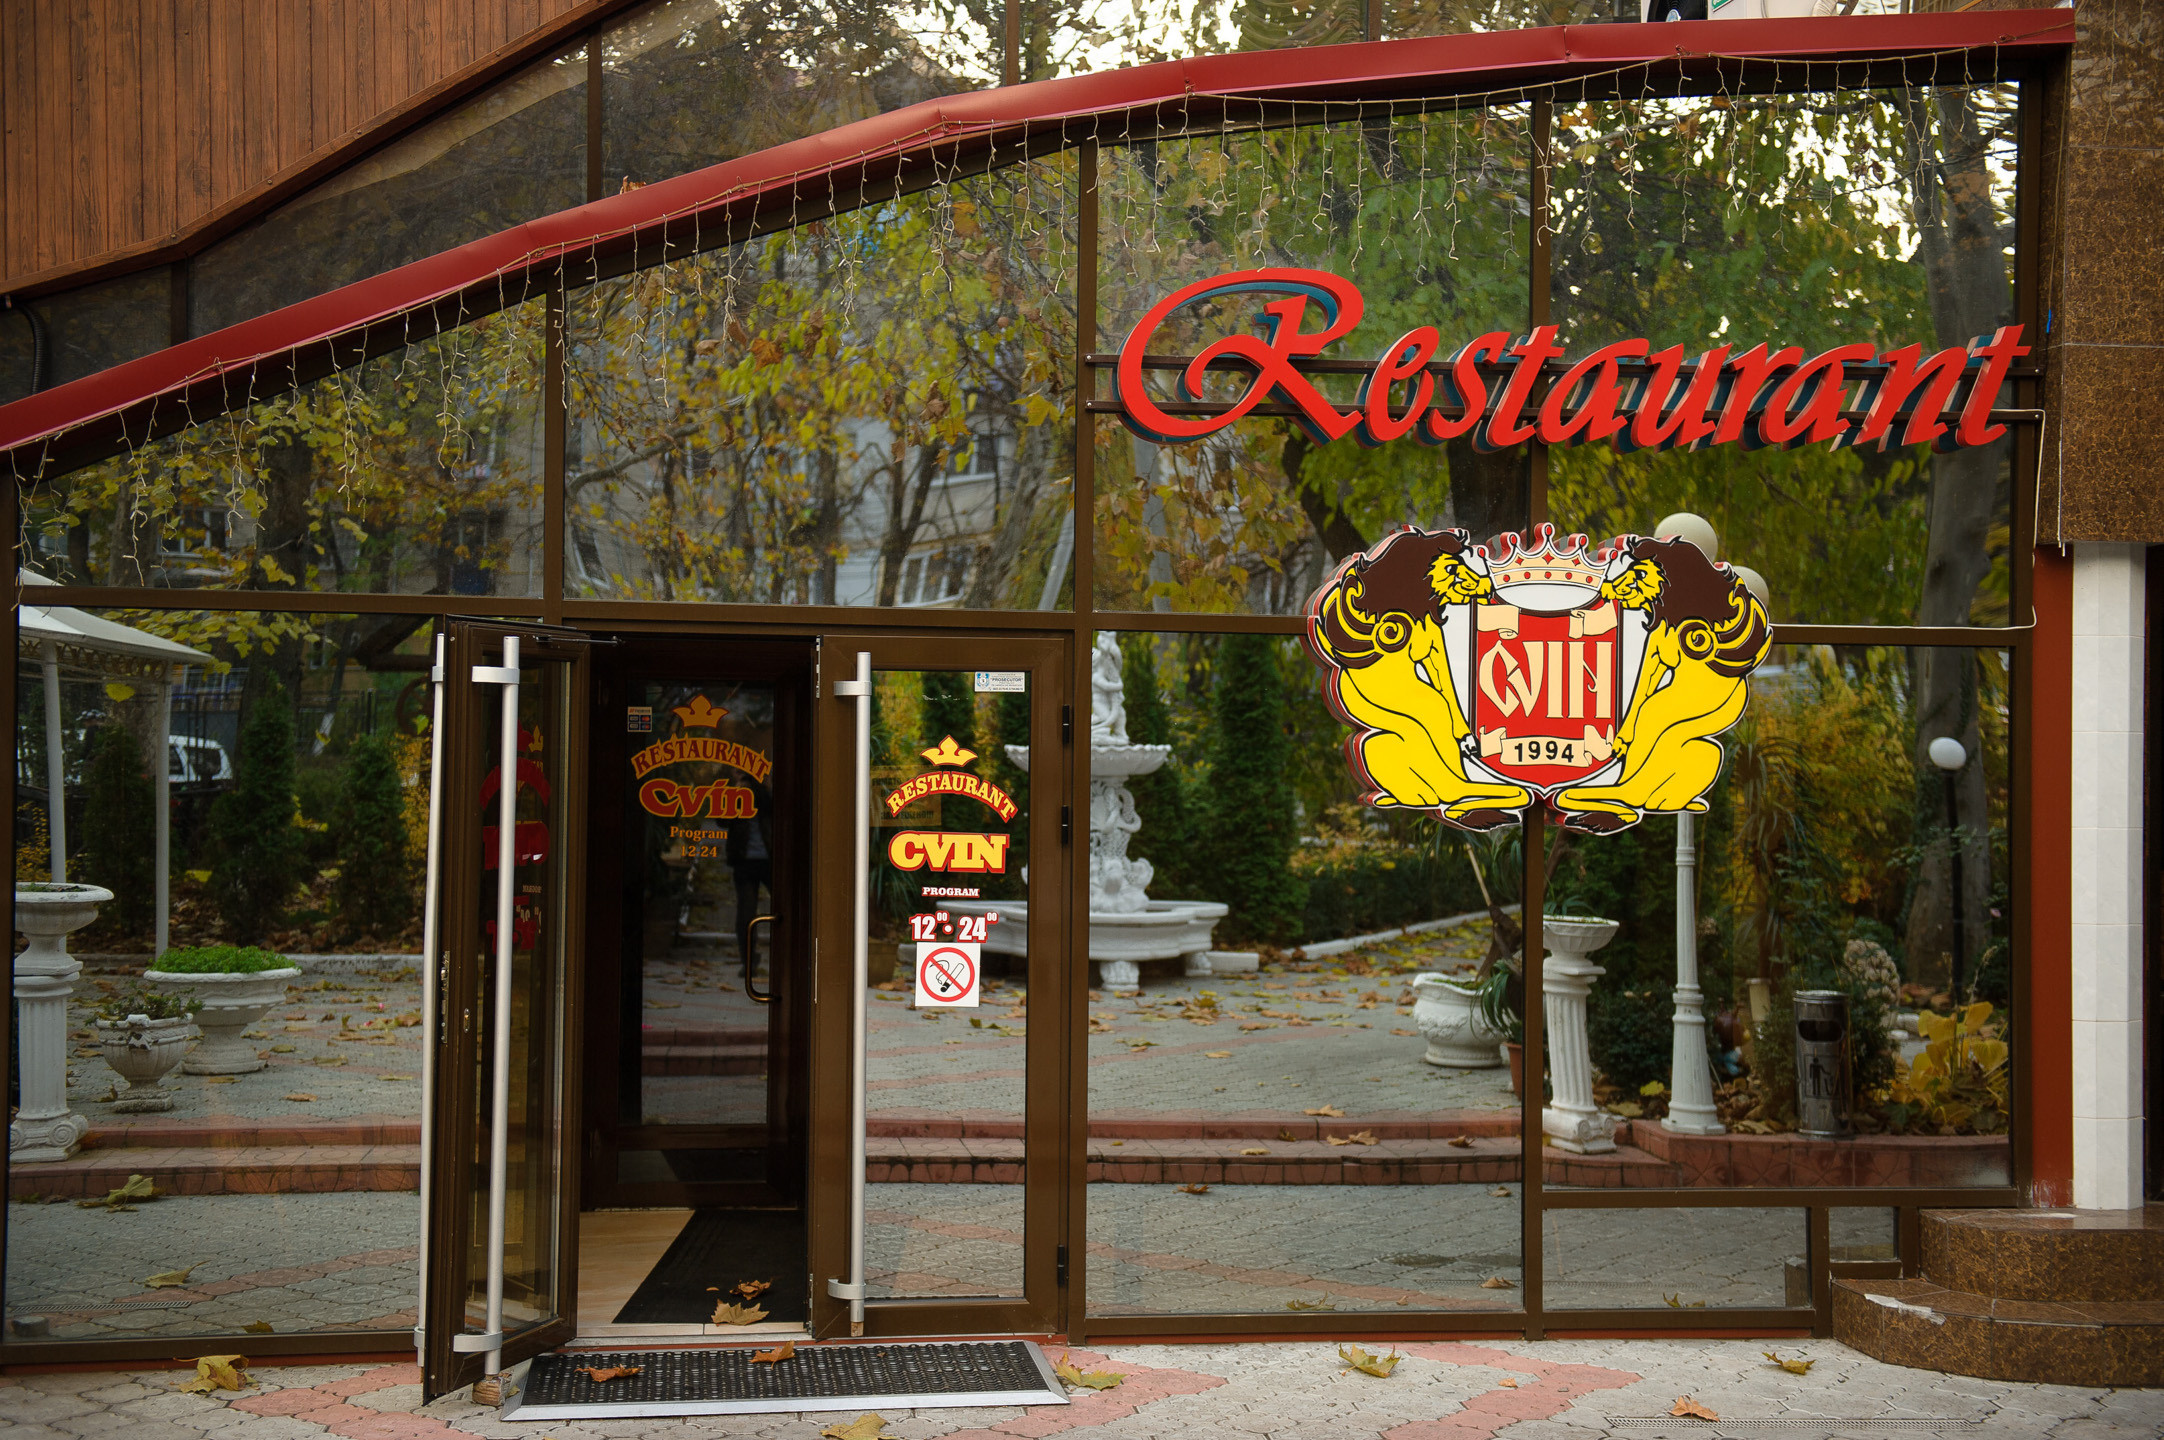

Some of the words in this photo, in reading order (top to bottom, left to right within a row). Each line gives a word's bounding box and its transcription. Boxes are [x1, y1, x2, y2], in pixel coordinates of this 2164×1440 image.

[1115, 266, 2032, 452] Restaurant
[631, 733, 773, 784] RESTAURANT
[1514, 740, 1575, 763] 1994
[885, 771, 1018, 823] RESTAURANT
[669, 826, 729, 842] Program
[681, 845, 718, 858] 12-24
[888, 830, 1010, 874] CVIN
[922, 887, 980, 898] PROGRAM
